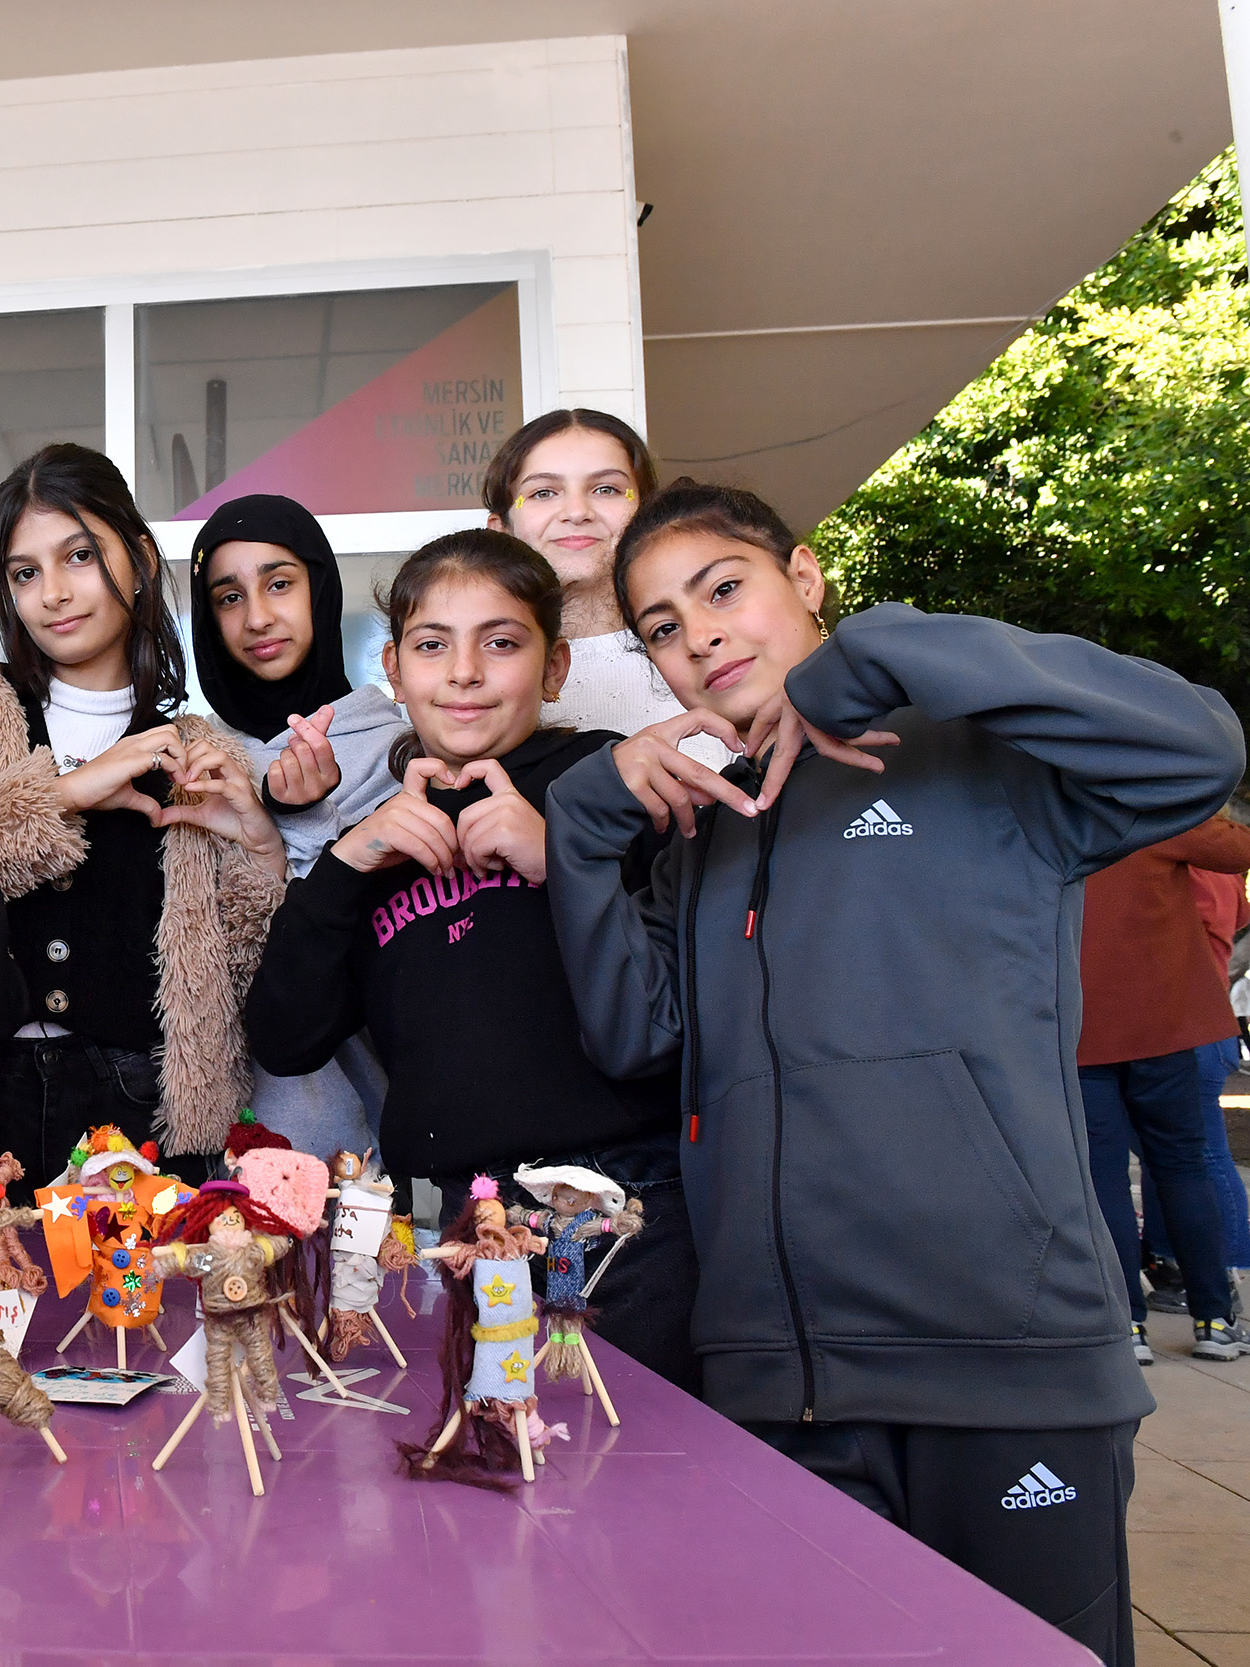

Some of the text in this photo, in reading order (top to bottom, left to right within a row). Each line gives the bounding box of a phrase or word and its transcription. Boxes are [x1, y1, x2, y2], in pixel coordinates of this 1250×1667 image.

[422, 374, 505, 404] MERSİN
[477, 410, 505, 435] VE
[843, 821, 914, 839] adidas
[371, 867, 539, 948] BROOKL
[1000, 1486, 1077, 1510] adidas
